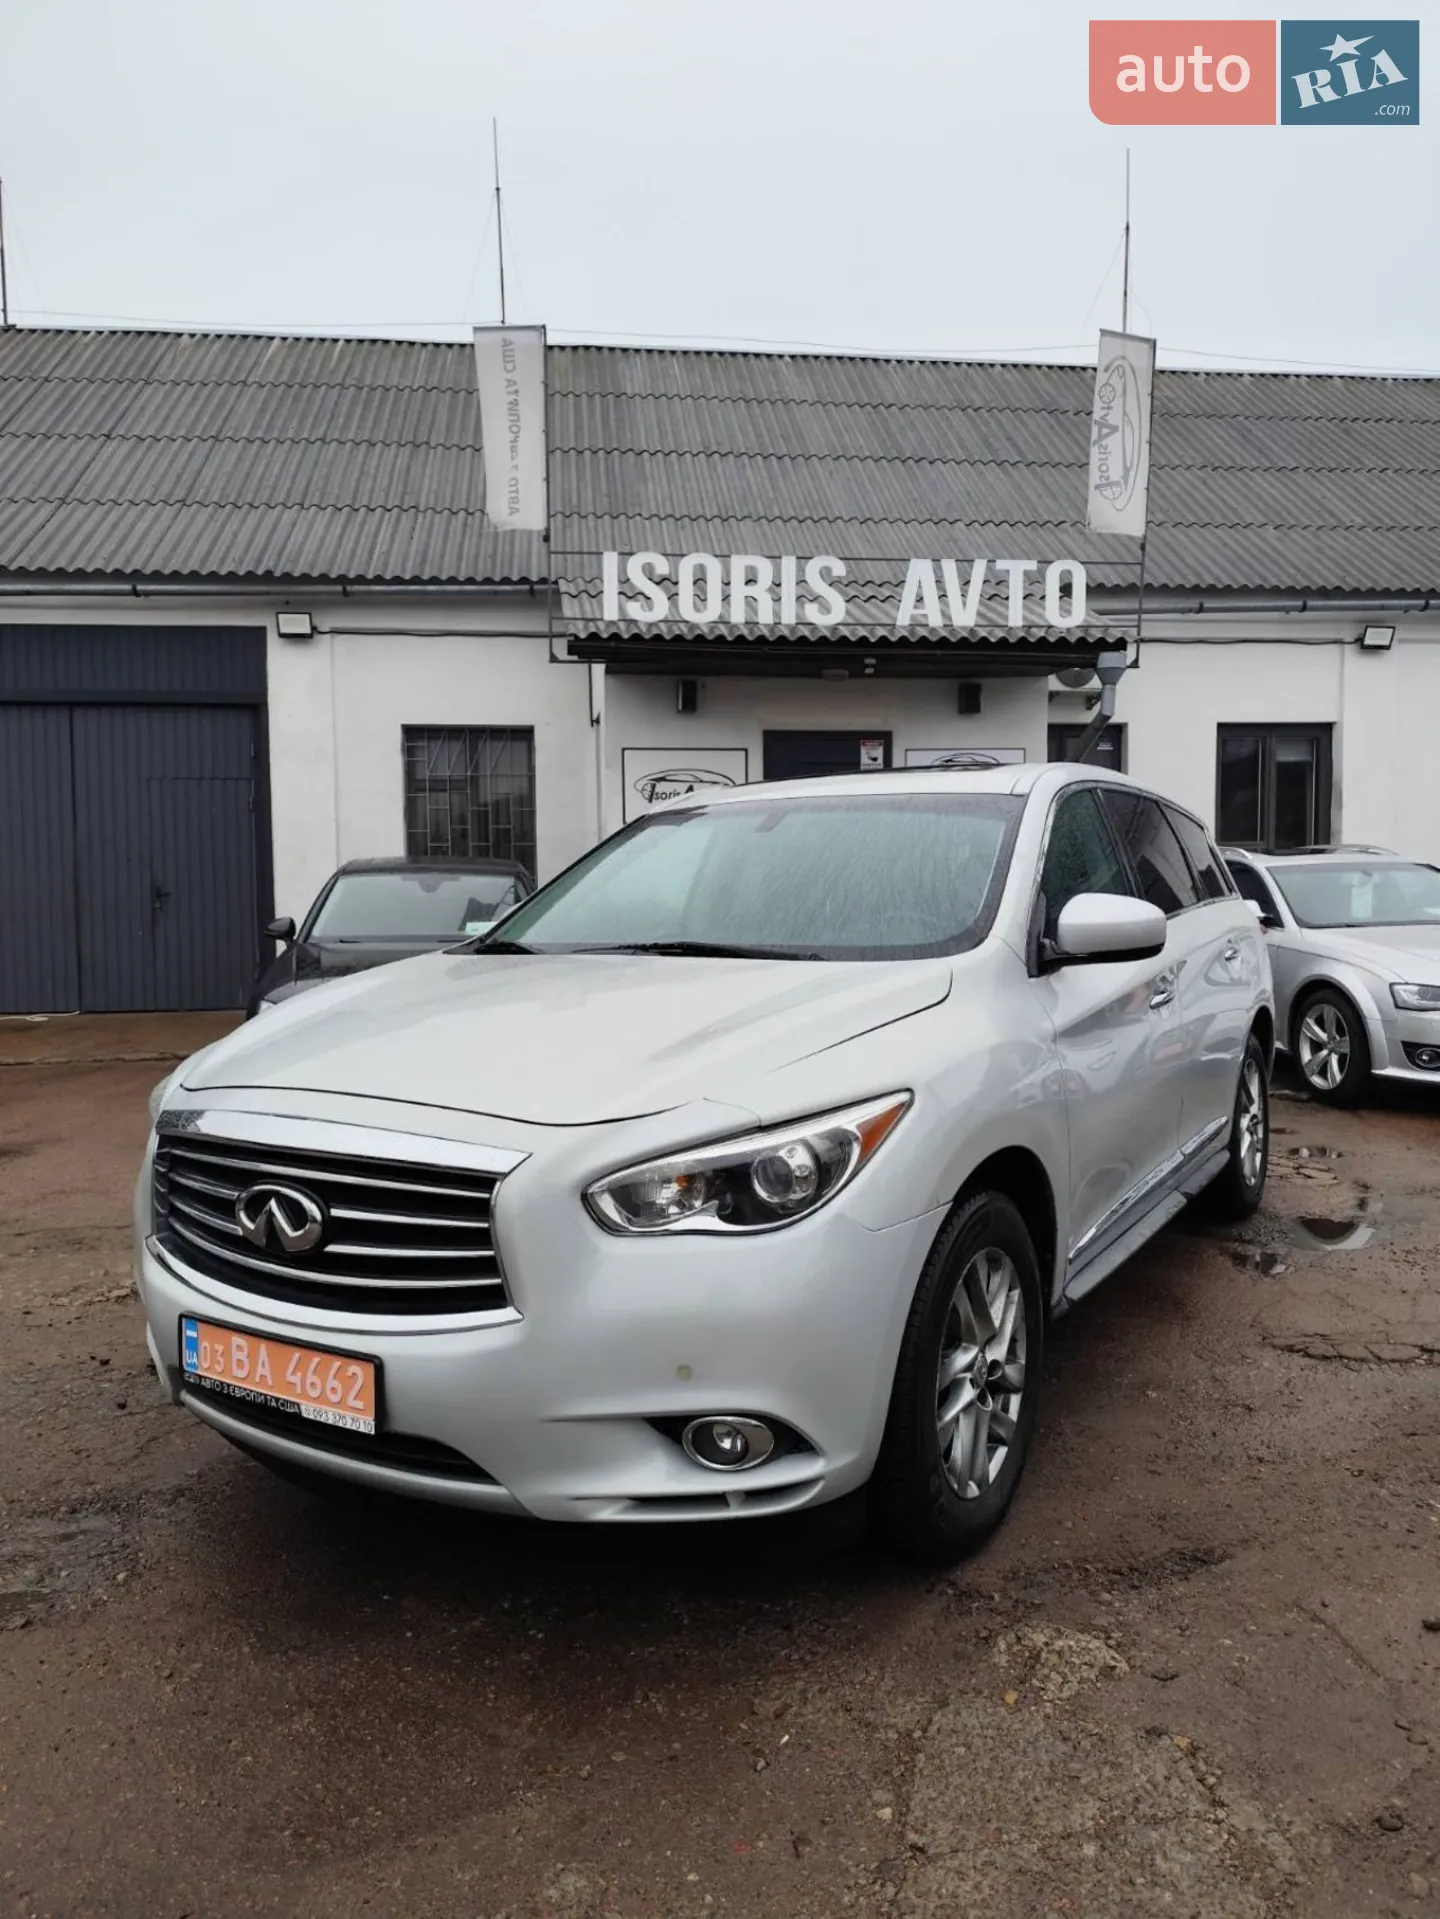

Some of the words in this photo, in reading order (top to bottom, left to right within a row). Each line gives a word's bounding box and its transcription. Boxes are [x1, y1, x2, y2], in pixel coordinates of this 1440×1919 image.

[602, 551, 848, 627] ISORIS
[895, 558, 1088, 628] AVTO
[186, 1353, 198, 1365] UA
[200, 1340, 224, 1373] 03
[285, 1352, 365, 1410] 4662
